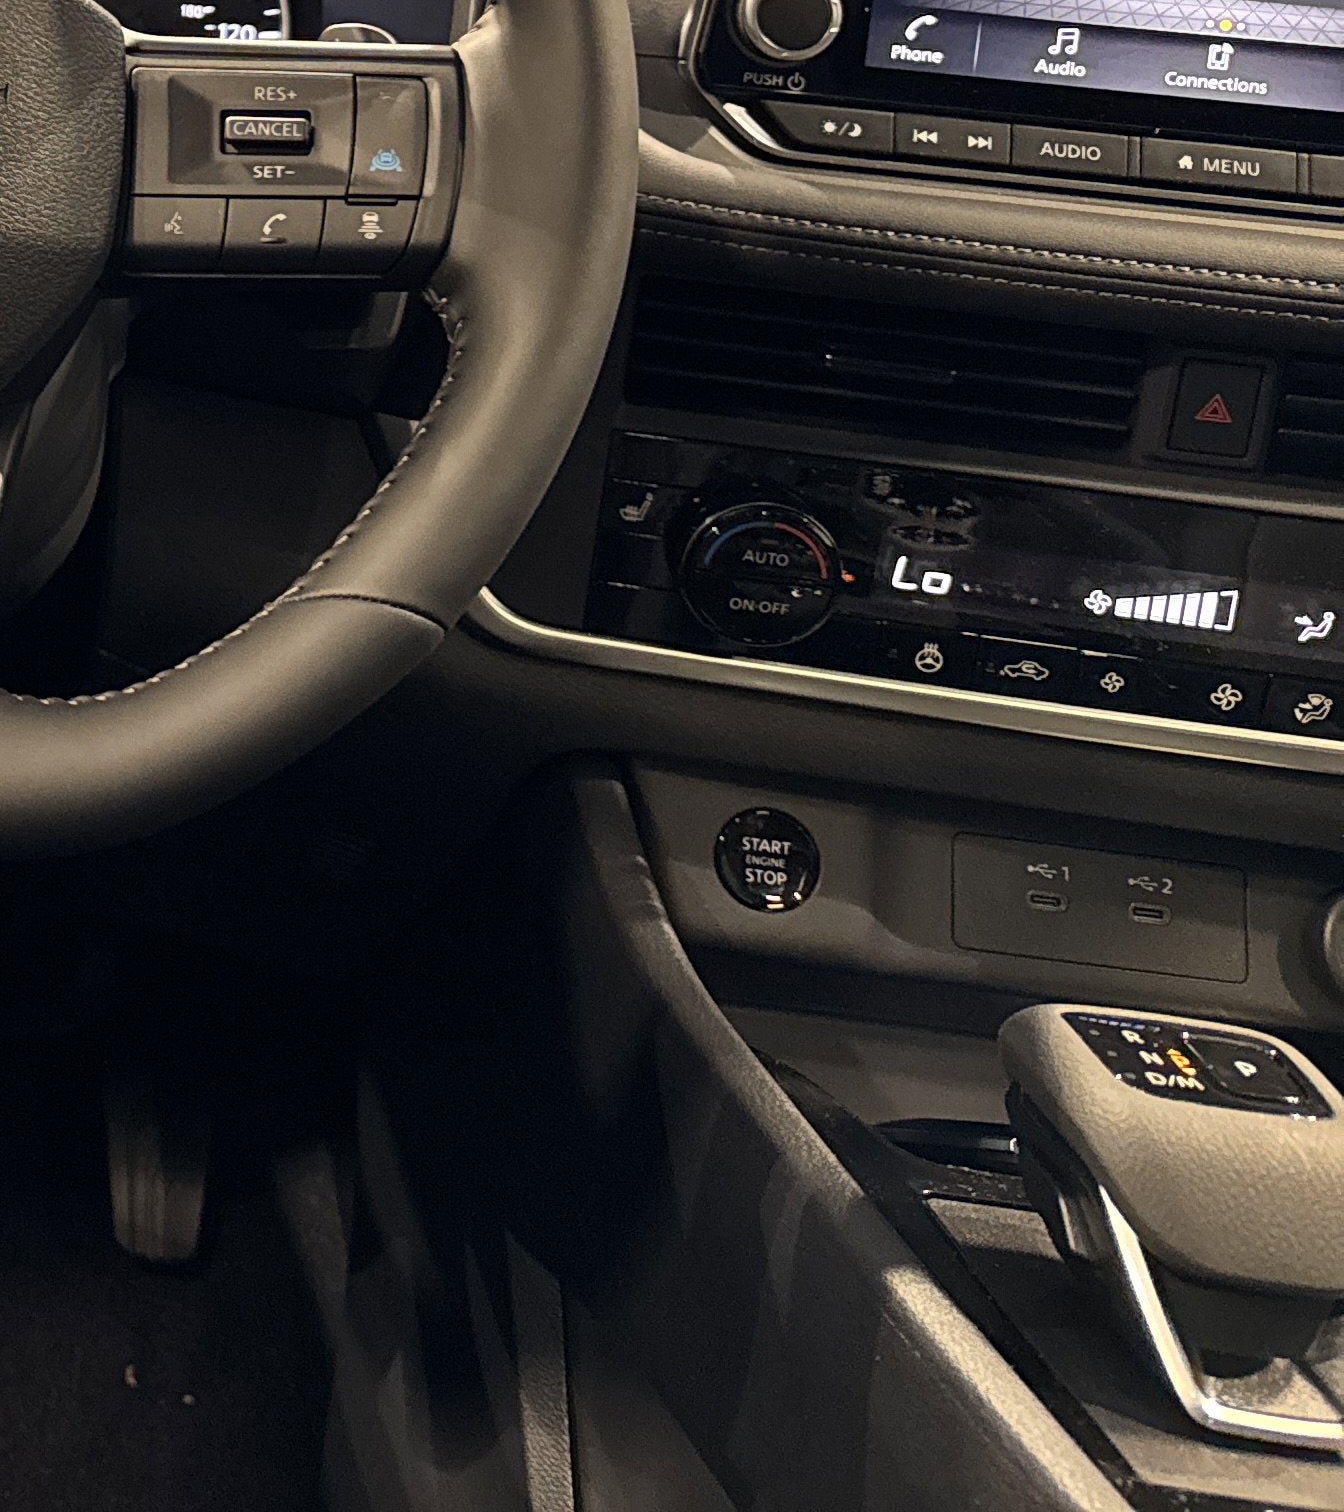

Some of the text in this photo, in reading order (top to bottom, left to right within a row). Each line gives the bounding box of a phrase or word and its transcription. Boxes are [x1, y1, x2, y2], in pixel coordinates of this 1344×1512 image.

[890, 44, 944, 65] Phone
[1033, 58, 1087, 79] Audio
[743, 71, 784, 88] PUSH
[1164, 70, 1269, 96] Connections
[254, 86, 298, 102] RES+
[233, 121, 302, 136] CANCEL
[1040, 140, 1102, 162] AUDIO
[1202, 157, 1261, 177] MENU
[742, 548, 790, 568] AUTO
[891, 554, 954, 595] Lo
[742, 836, 792, 855] START
[745, 854, 786, 868] ENGINE
[745, 868, 788, 885] STOP
[1161, 878, 1173, 894] 2
[1121, 1029, 1145, 1045] R
[1138, 1050, 1165, 1066] N
[1234, 1060, 1257, 1077] P
[1144, 1071, 1205, 1092] D/M
